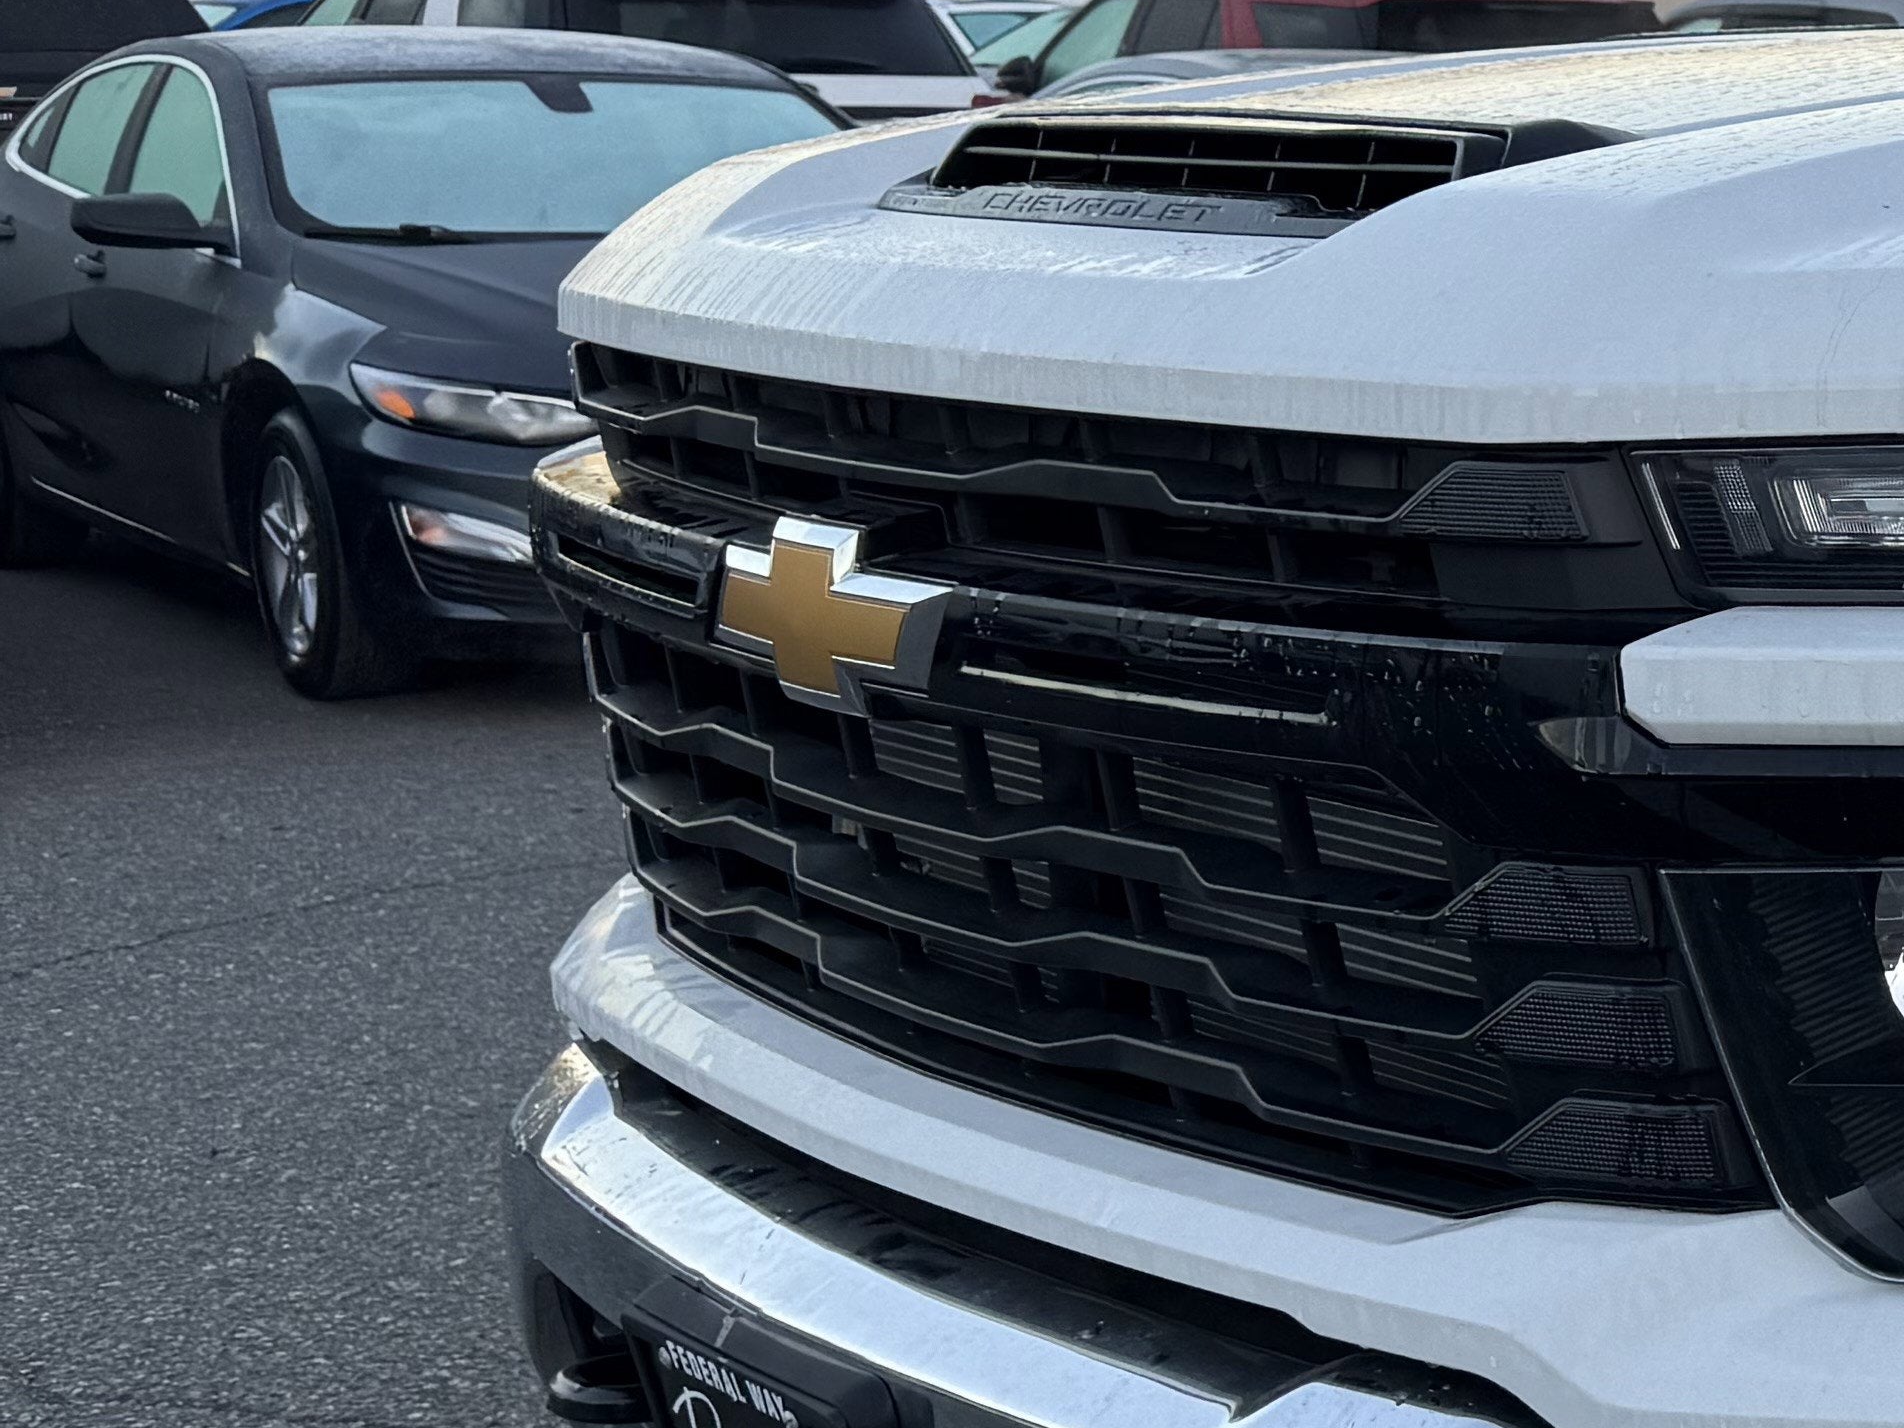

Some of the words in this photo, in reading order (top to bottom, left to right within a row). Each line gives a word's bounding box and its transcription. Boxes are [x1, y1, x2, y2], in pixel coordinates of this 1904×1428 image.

[982, 191, 1223, 223] CHEVROLET
[666, 1339, 747, 1404] FEDERAL
[745, 1379, 784, 1422] WAY
